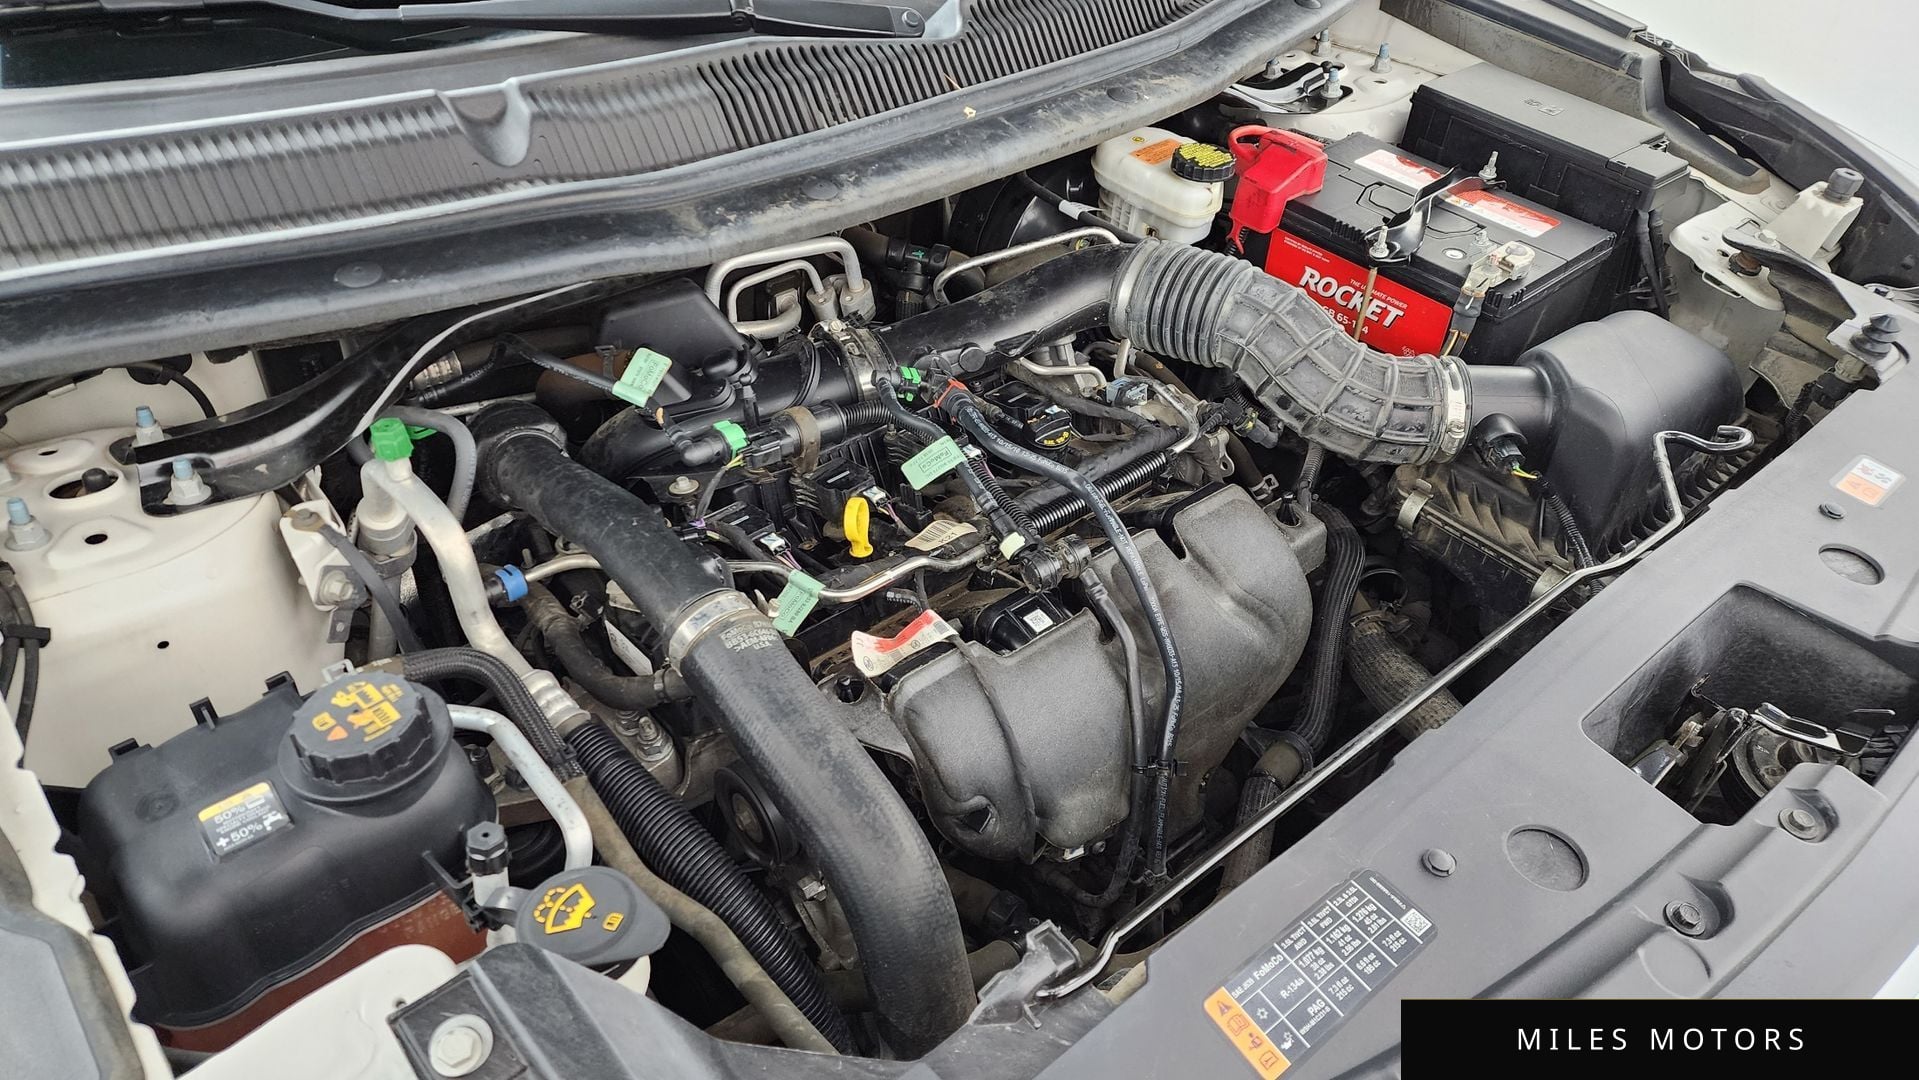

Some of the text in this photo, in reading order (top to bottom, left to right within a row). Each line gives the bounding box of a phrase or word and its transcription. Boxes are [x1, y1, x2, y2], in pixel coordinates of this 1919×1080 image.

[1299, 266, 1404, 327] ROCKET
[1350, 279, 1408, 310] THE UMATE POWER
[1336, 313, 1368, 334] 65-14
[922, 448, 950, 470] FoMoCo
[752, 640, 772, 650] USA
[230, 822, 263, 842] 50%
[1351, 901, 1377, 923] 1.276 kg
[1364, 912, 1378, 926] 45 oz
[1339, 922, 1352, 935] kg
[1377, 916, 1387, 926] lbs
[1293, 937, 1308, 951] AWD
[1337, 934, 1353, 948] 41 oz
[1351, 937, 1362, 948] lbs
[1381, 936, 1394, 948] 7.3
[1392, 929, 1402, 938] oz
[1389, 936, 1407, 953] 215 cc
[1298, 944, 1325, 968] 1.077 kg
[1317, 956, 1326, 966] oz
[1367, 951, 1376, 961] oz
[1372, 958, 1381, 967] cc
[1252, 951, 1284, 980] FoMoCo
[1324, 960, 1335, 971] lbs
[1279, 975, 1305, 1000] R-134a
[1328, 983, 1340, 995] 7.3
[1340, 975, 1349, 985] oz
[1335, 983, 1354, 1000] 215 cc
[1306, 997, 1326, 1016] PAG
